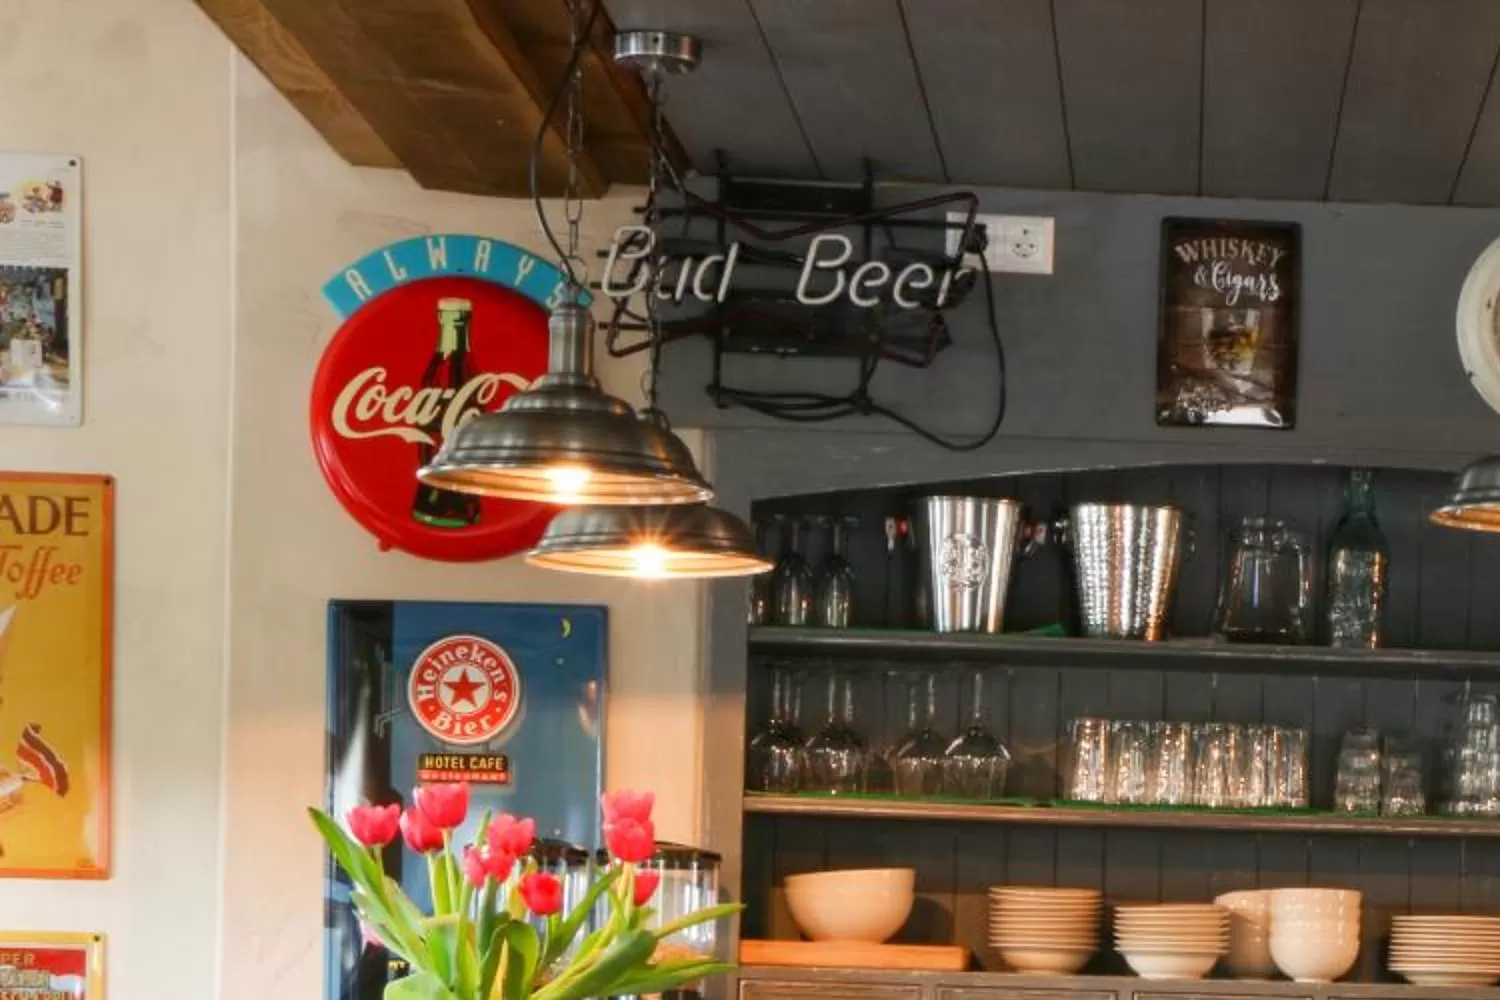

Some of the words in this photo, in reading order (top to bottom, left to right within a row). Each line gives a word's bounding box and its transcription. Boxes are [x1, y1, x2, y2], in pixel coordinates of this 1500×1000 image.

[600, 225, 739, 303] Bud
[796, 233, 974, 309] Beer
[1174, 238, 1283, 268] WHISKEY
[1193, 267, 1208, 287] &
[1210, 260, 1281, 305] Cigars
[331, 366, 547, 446] Coca-C
[417, 642, 509, 702] Heinekens
[432, 710, 493, 736] Bier
[424, 755, 466, 769] HOTEL
[468, 756, 505, 771] CAFE
